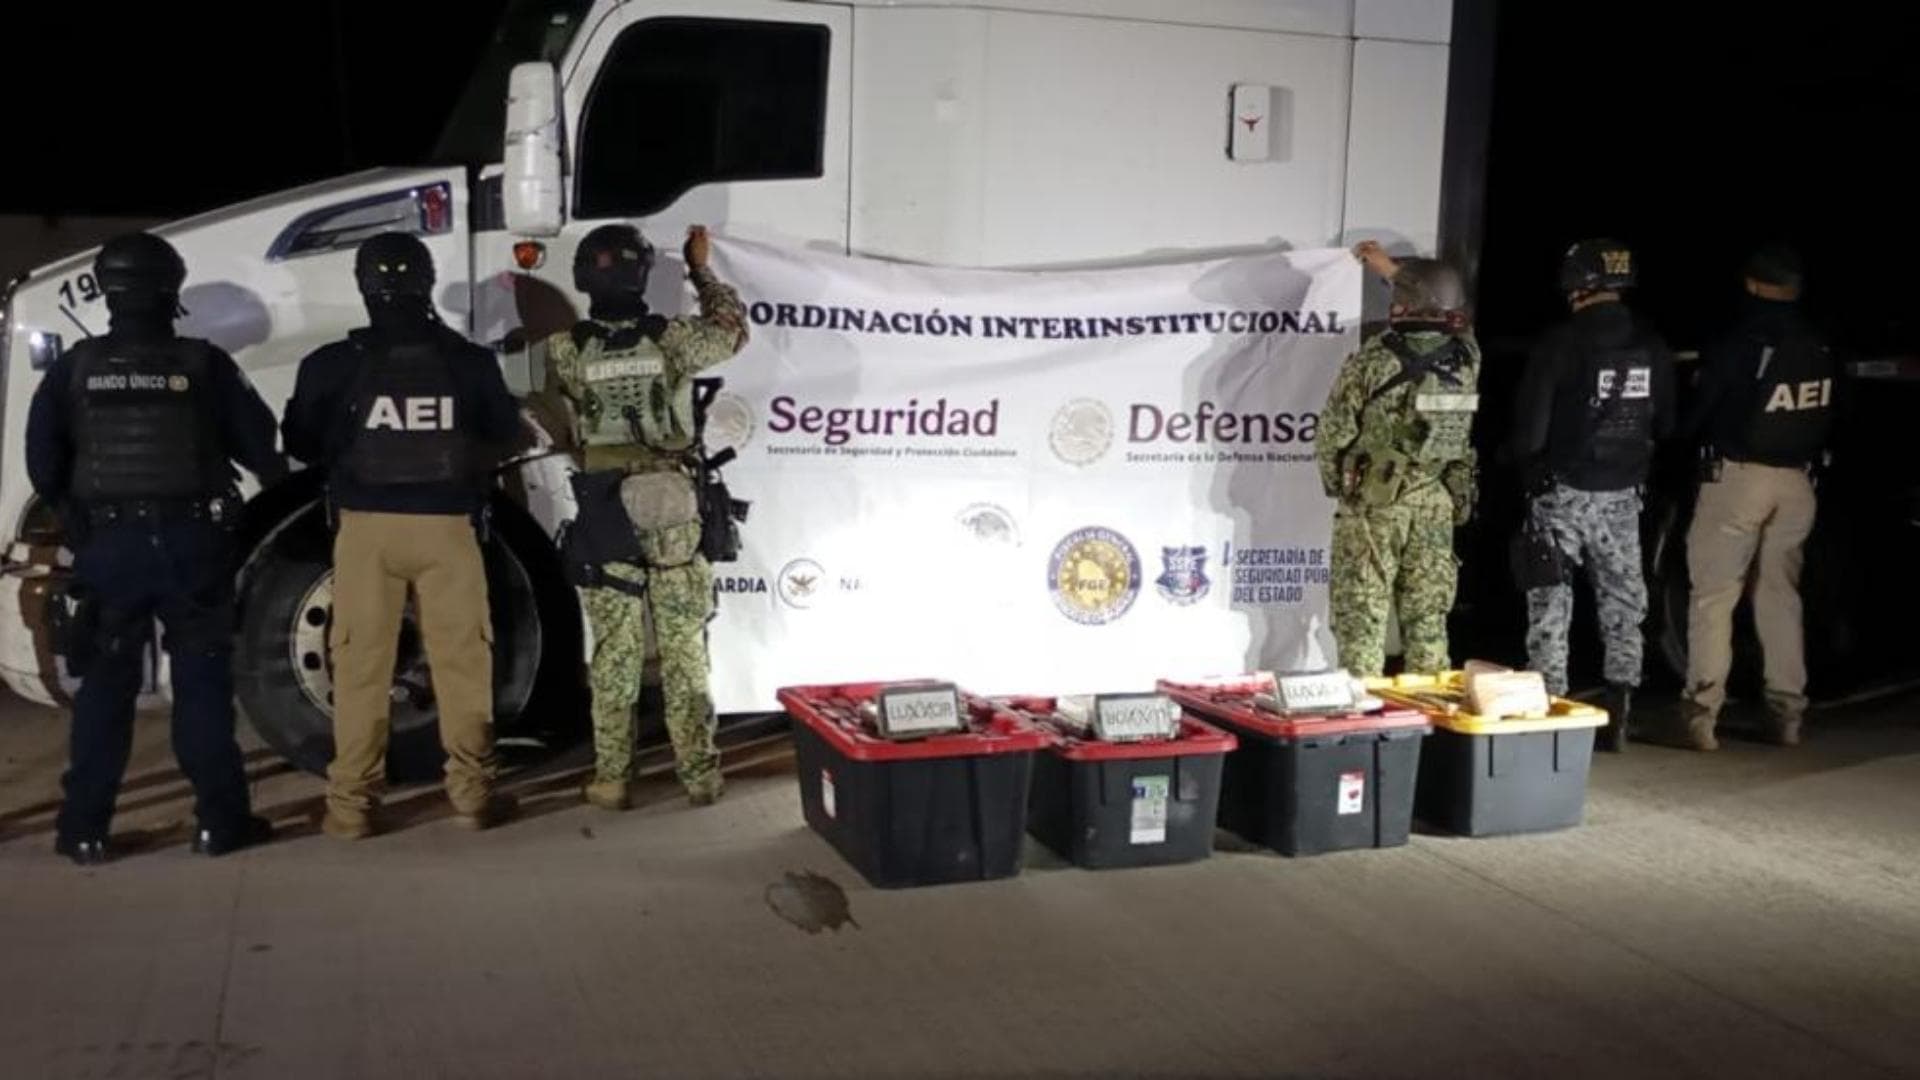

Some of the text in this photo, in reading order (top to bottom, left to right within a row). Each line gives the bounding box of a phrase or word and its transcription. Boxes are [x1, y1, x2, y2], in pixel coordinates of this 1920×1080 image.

[741, 301, 1344, 339] ORDINACIÓN INTERINSTITUCIONAL
[1764, 378, 1832, 412] AEI
[365, 396, 454, 431] AEI
[767, 396, 999, 445] Seguridad
[1127, 401, 1319, 443] Defensa
[825, 446, 836, 456] de
[840, 446, 892, 459] Seguridad
[1188, 453, 1201, 463] de
[1217, 452, 1264, 463] Defensa
[1309, 549, 1324, 565] DE
[1235, 567, 1301, 583] SEGURIDAD
[1233, 586, 1303, 603] DEL ESTADO
